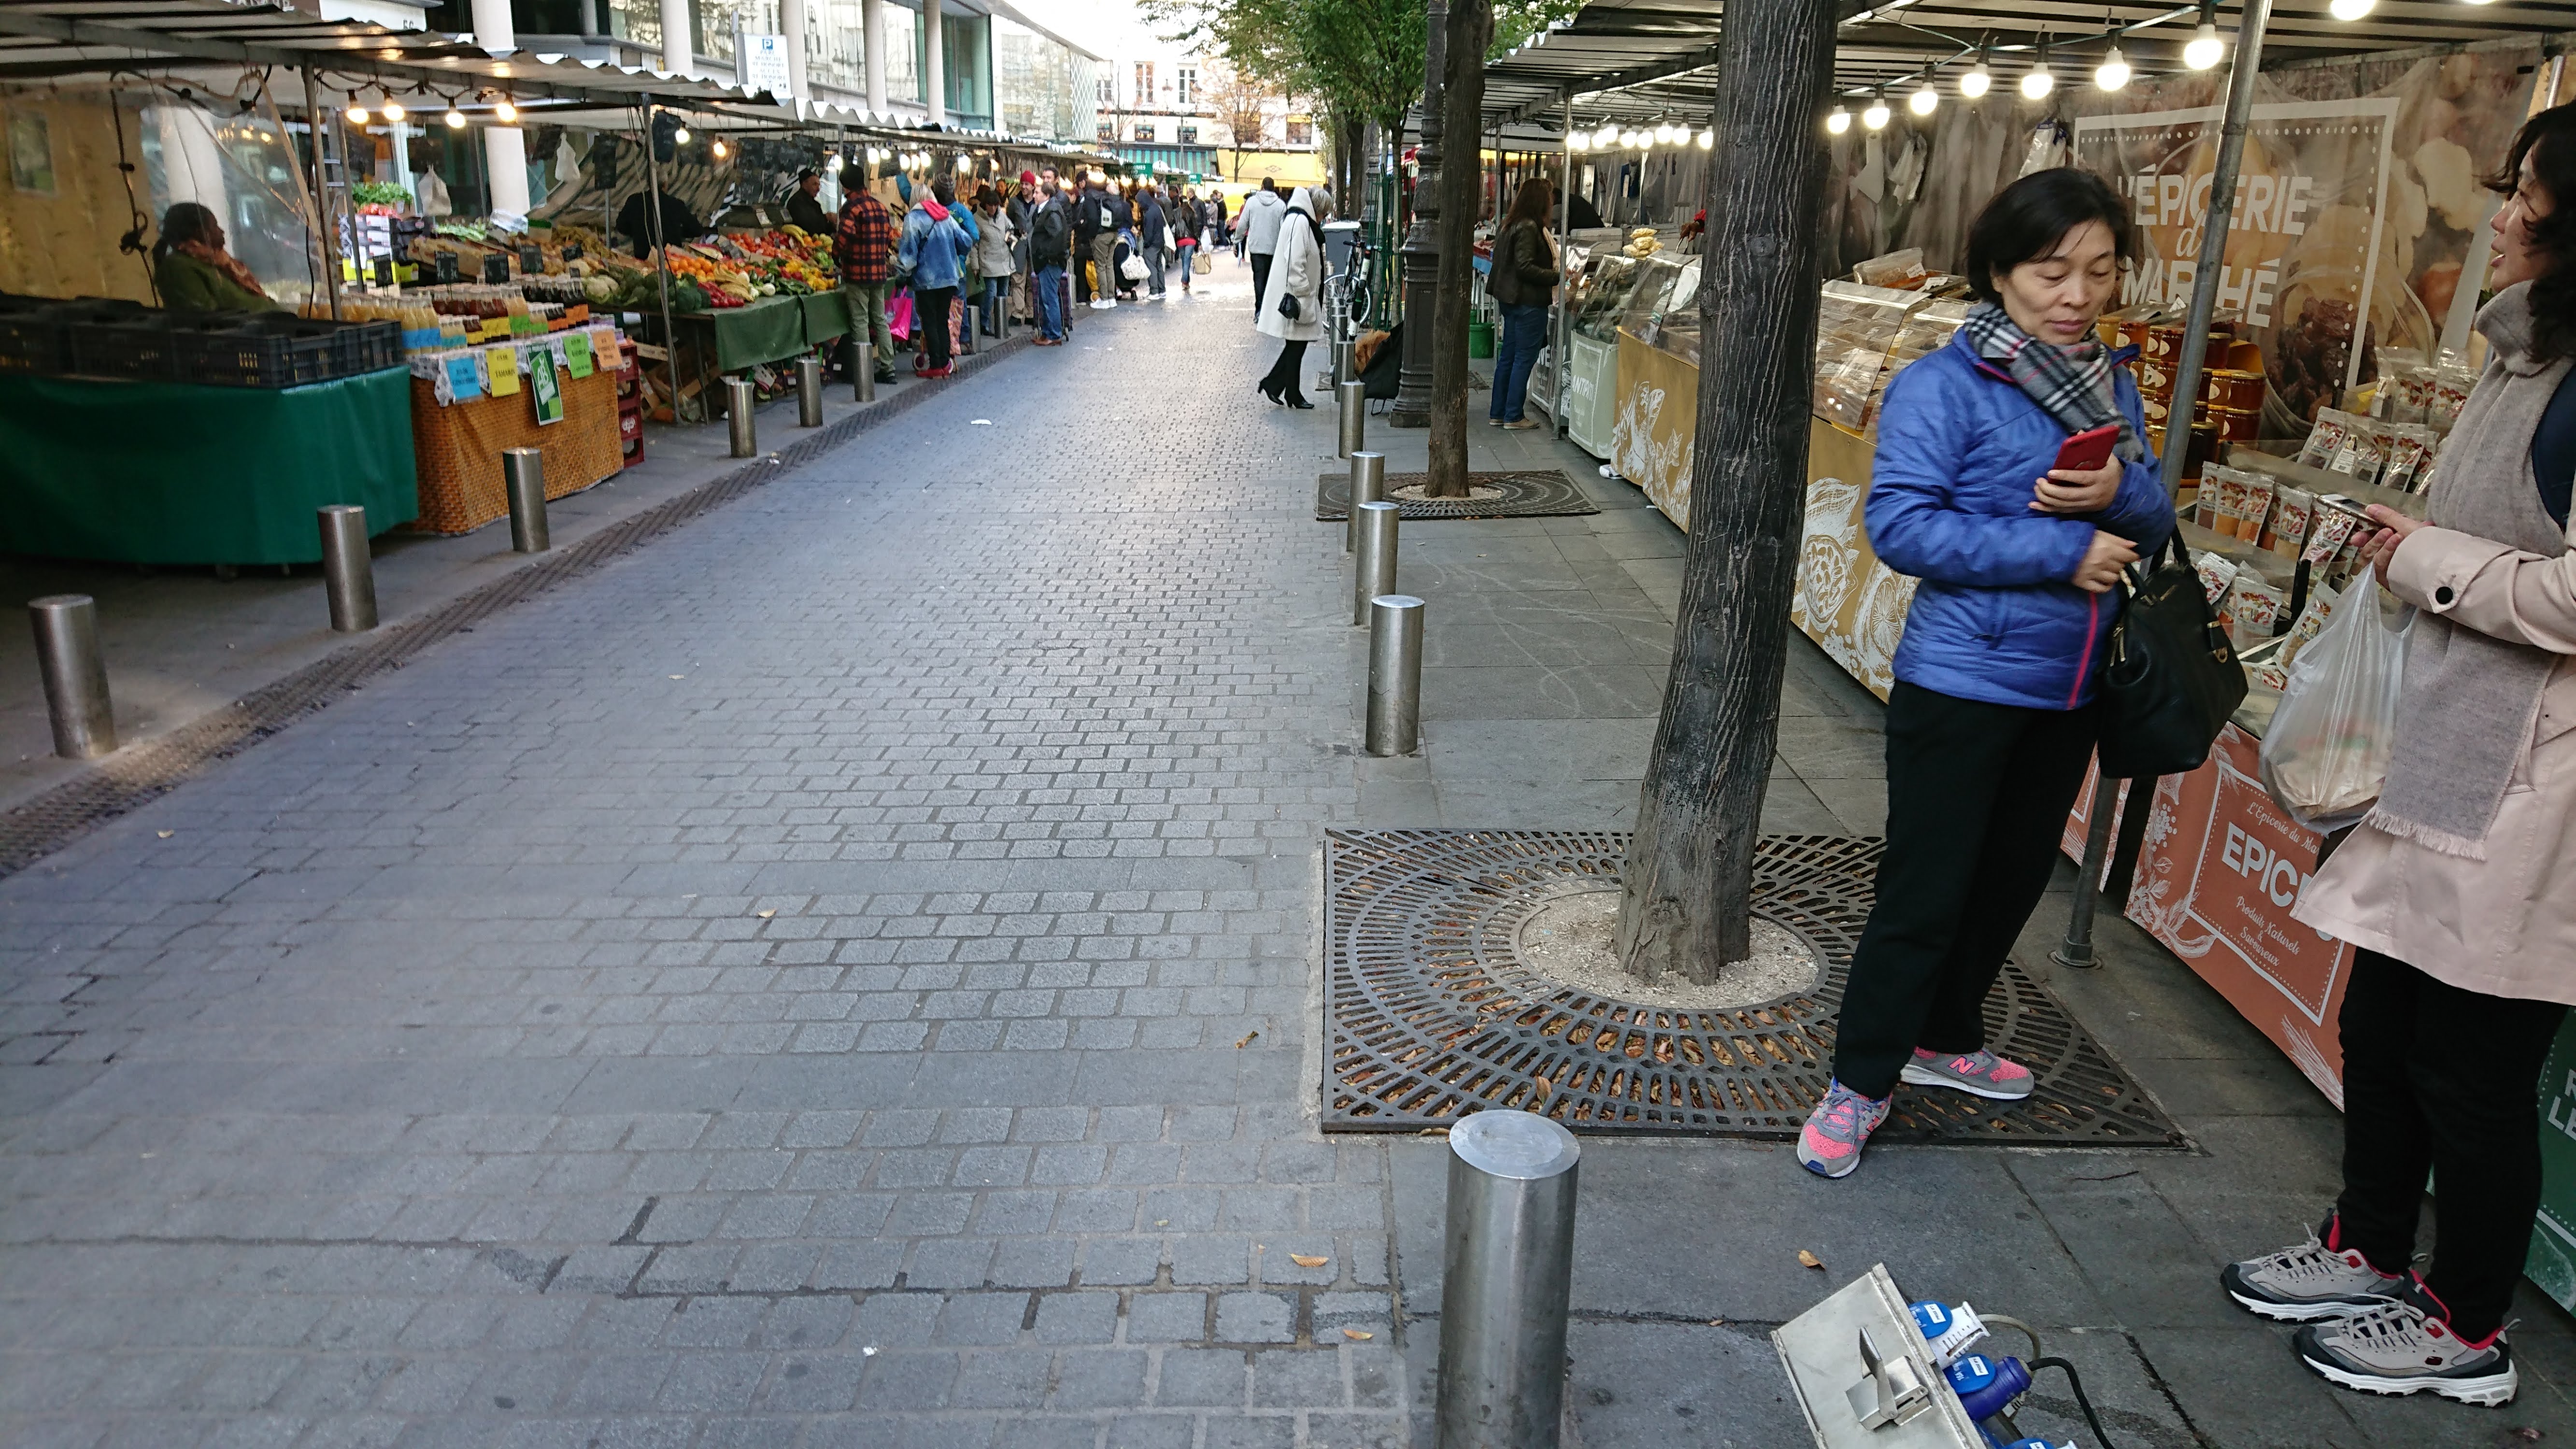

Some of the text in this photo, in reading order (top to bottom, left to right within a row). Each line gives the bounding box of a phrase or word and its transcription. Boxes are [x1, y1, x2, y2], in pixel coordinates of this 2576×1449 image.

[2121, 256, 2280, 328] MARHÉ
[2246, 801, 2320, 854] L'Epicerie du Ma
[2235, 895, 2300, 956] Produits Naturels
[2239, 926, 2280, 967] Savoureux
[2257, 929, 2263, 942] &
[1948, 1055, 1977, 1075] N
